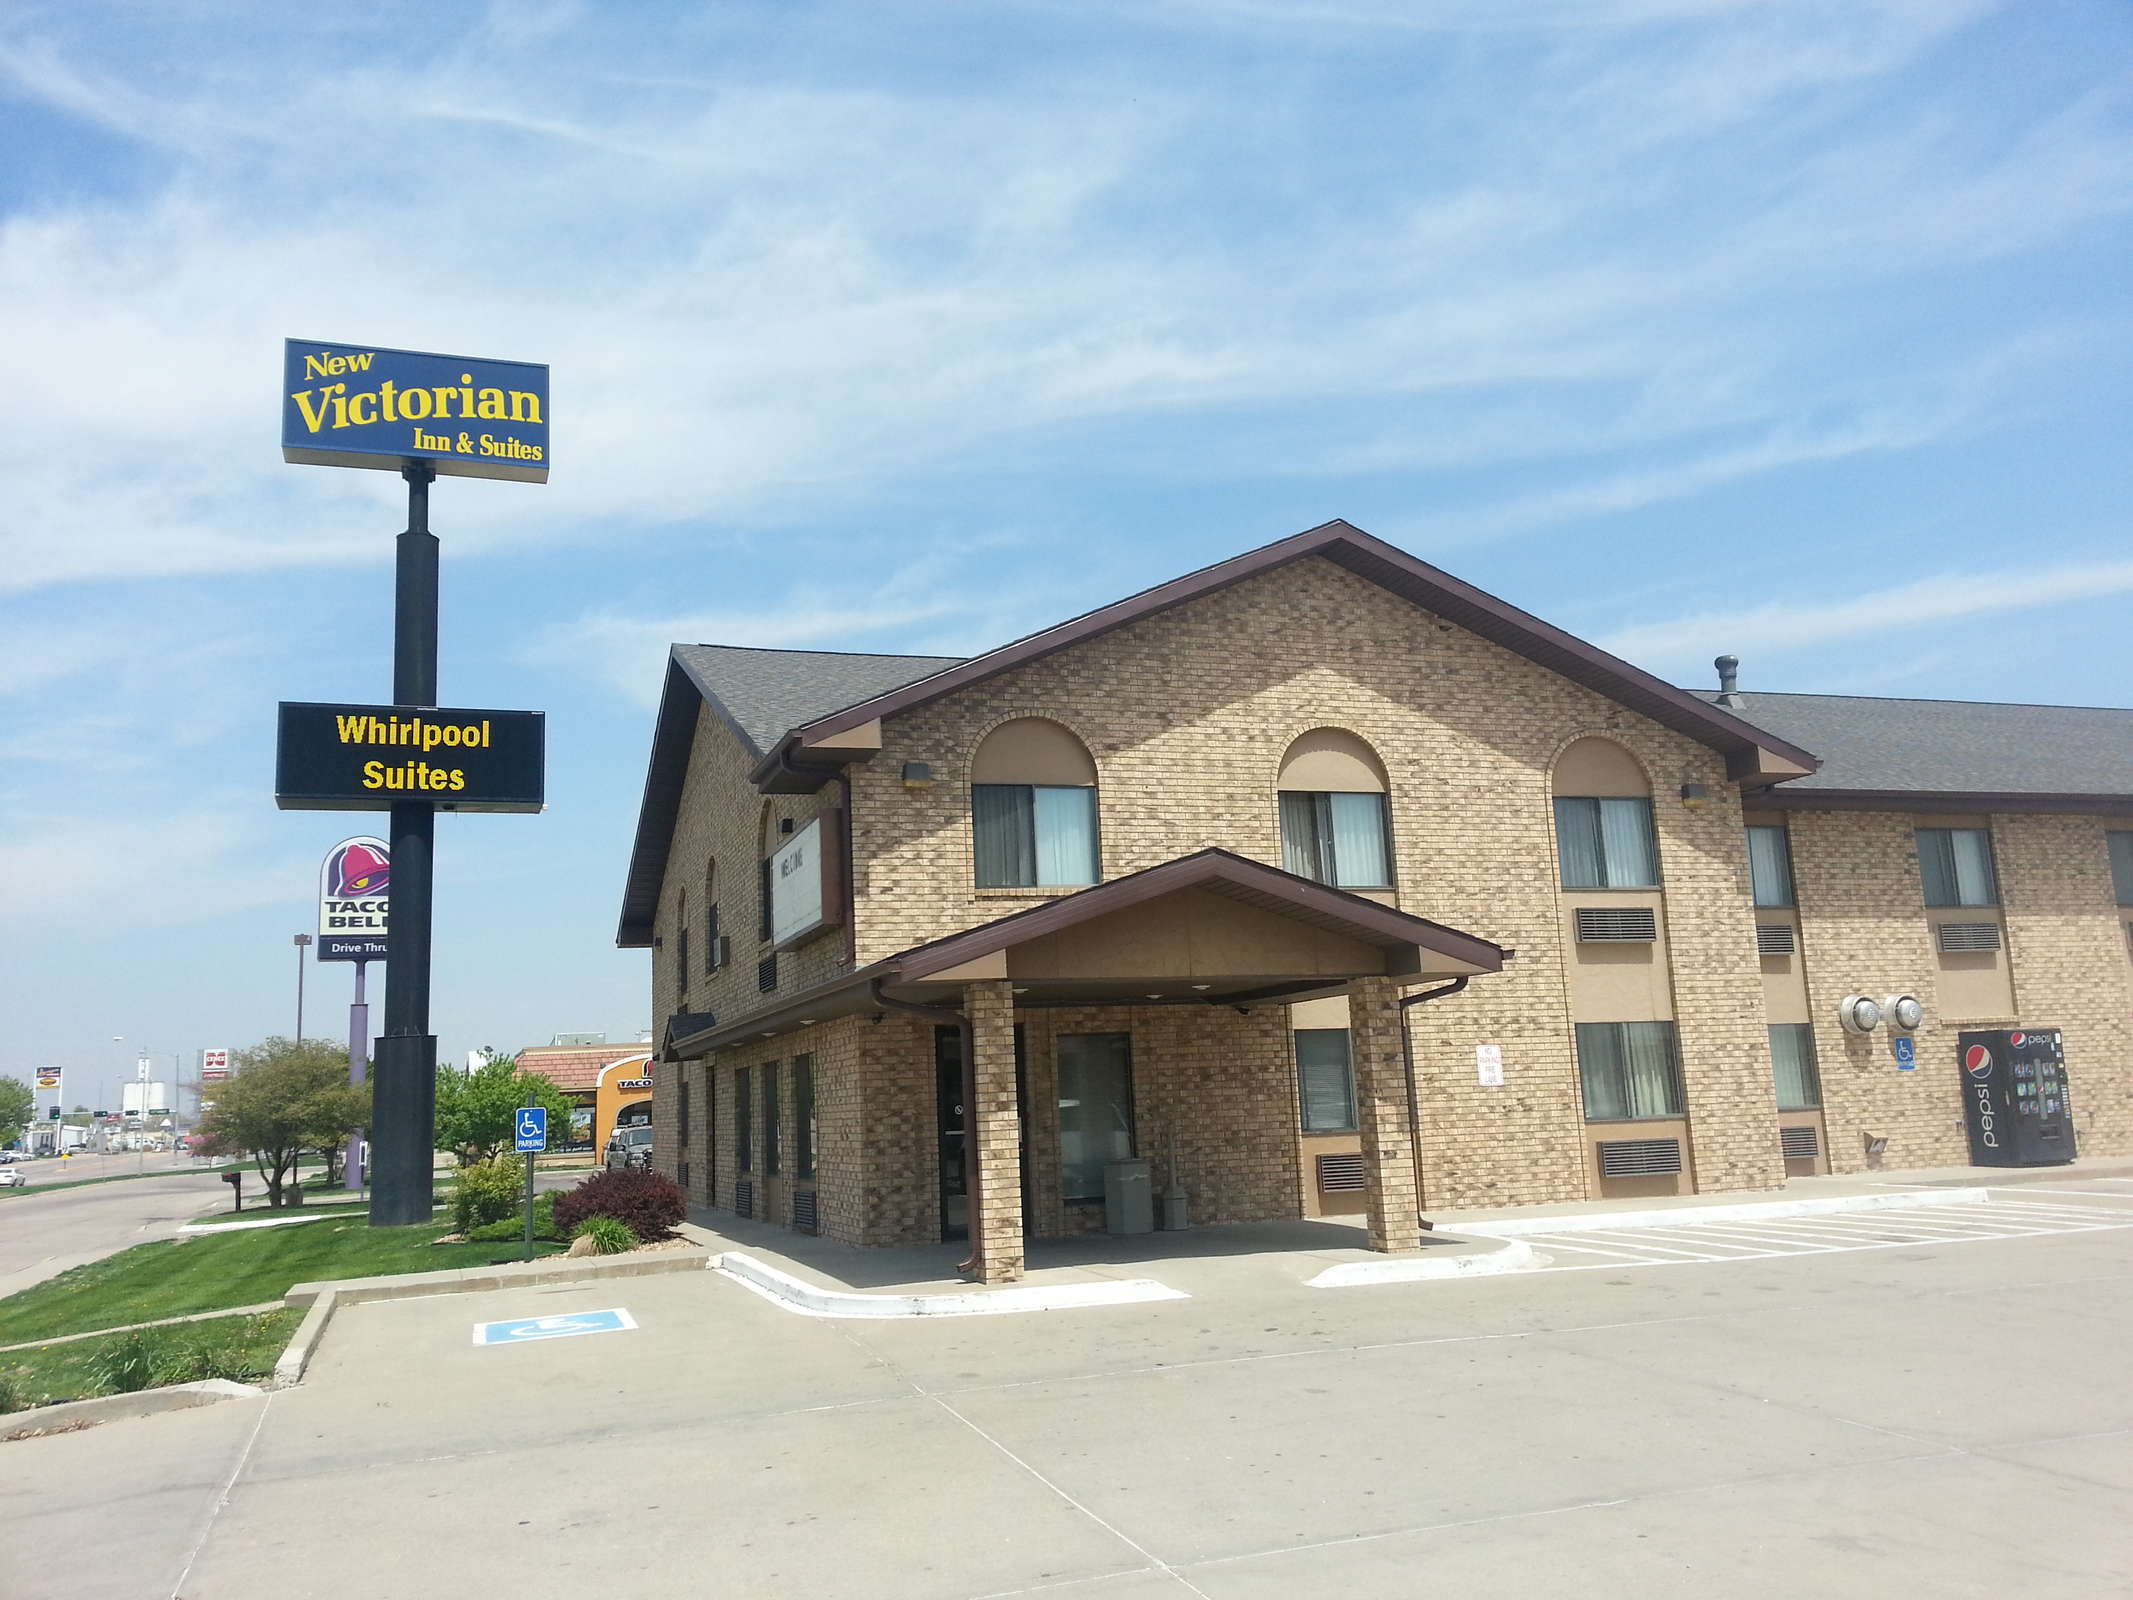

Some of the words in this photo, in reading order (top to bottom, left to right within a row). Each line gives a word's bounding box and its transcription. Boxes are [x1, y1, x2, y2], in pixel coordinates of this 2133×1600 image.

[303, 351, 375, 381] New
[291, 373, 544, 434] Victorian
[413, 427, 451, 452] Inn
[455, 431, 474, 454] &
[479, 433, 544, 461] Suites
[335, 714, 490, 752] Whirlpool
[362, 760, 466, 791] Suites
[324, 901, 389, 913] TACO
[331, 943, 361, 953] Drive
[619, 1079, 652, 1088] TACO
[1973, 1083, 1999, 1148] pepsi
[518, 1139, 544, 1148] PARKING
